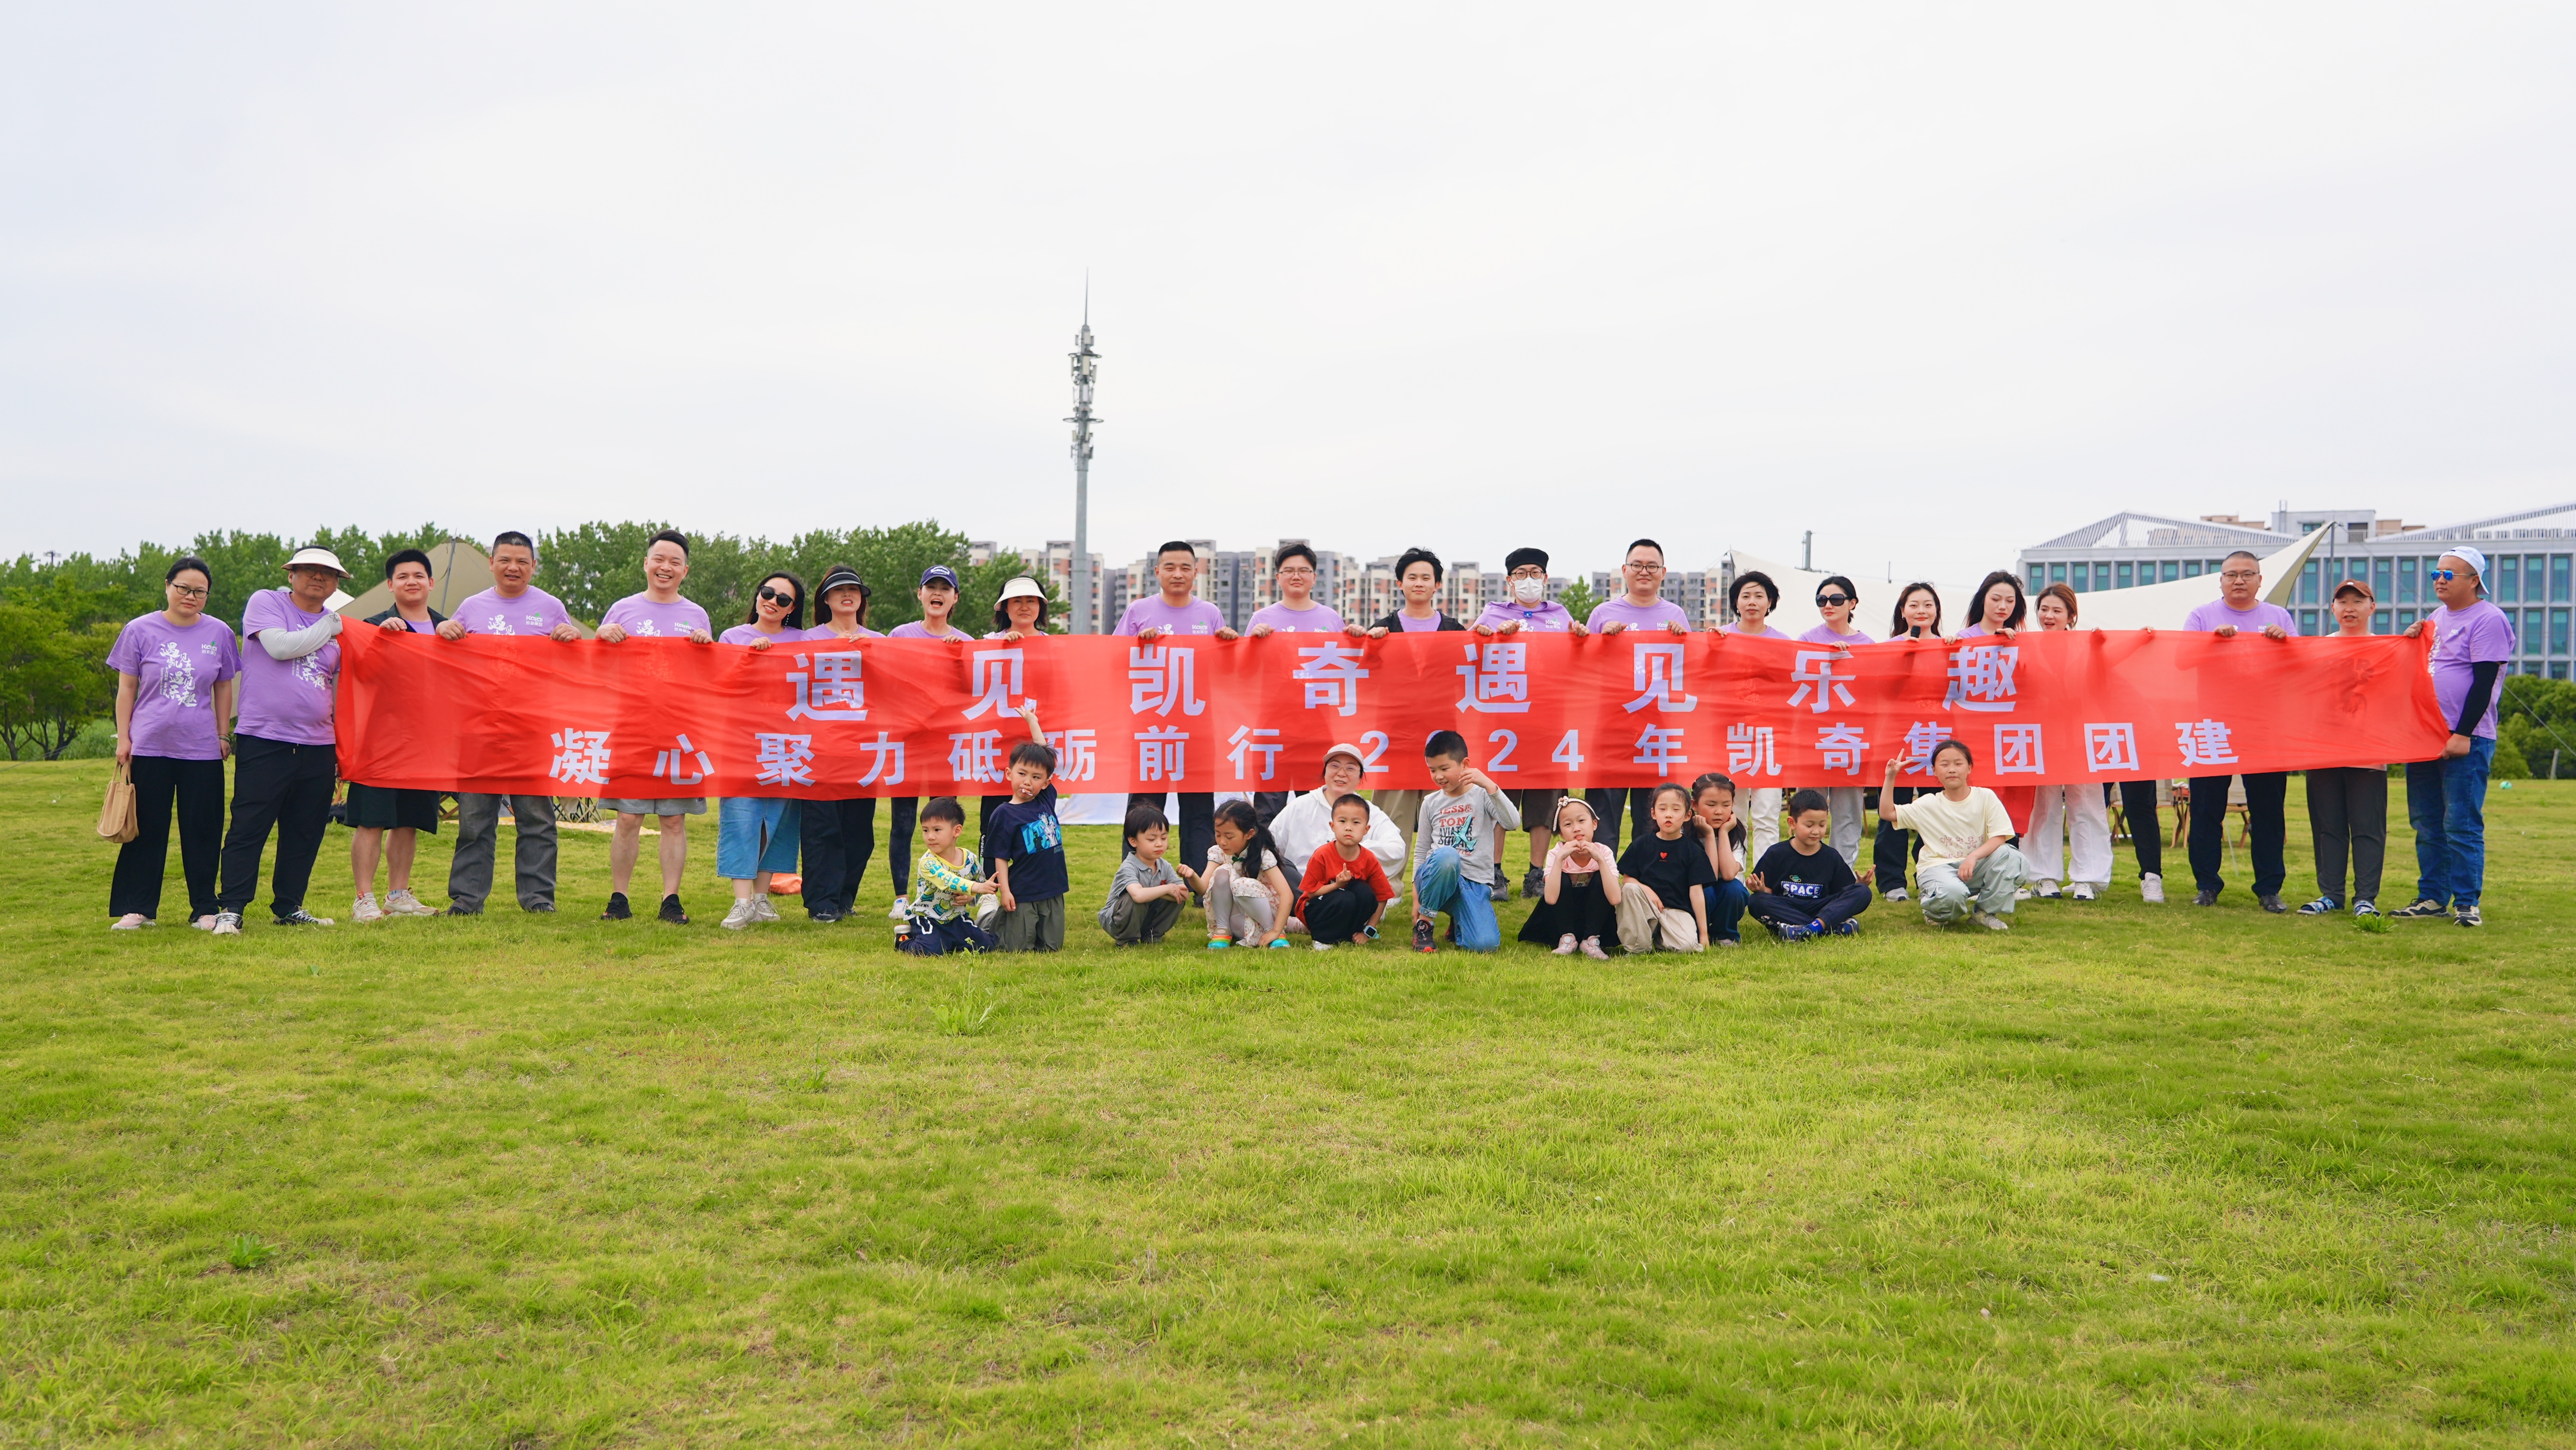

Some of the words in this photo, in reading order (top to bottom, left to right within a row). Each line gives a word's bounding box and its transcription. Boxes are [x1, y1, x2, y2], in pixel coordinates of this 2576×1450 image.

[785, 641, 2019, 722] 遇见凯奇遇见乐趣
[1439, 816, 1475, 827] TON
[1783, 883, 1820, 895] SPACE
